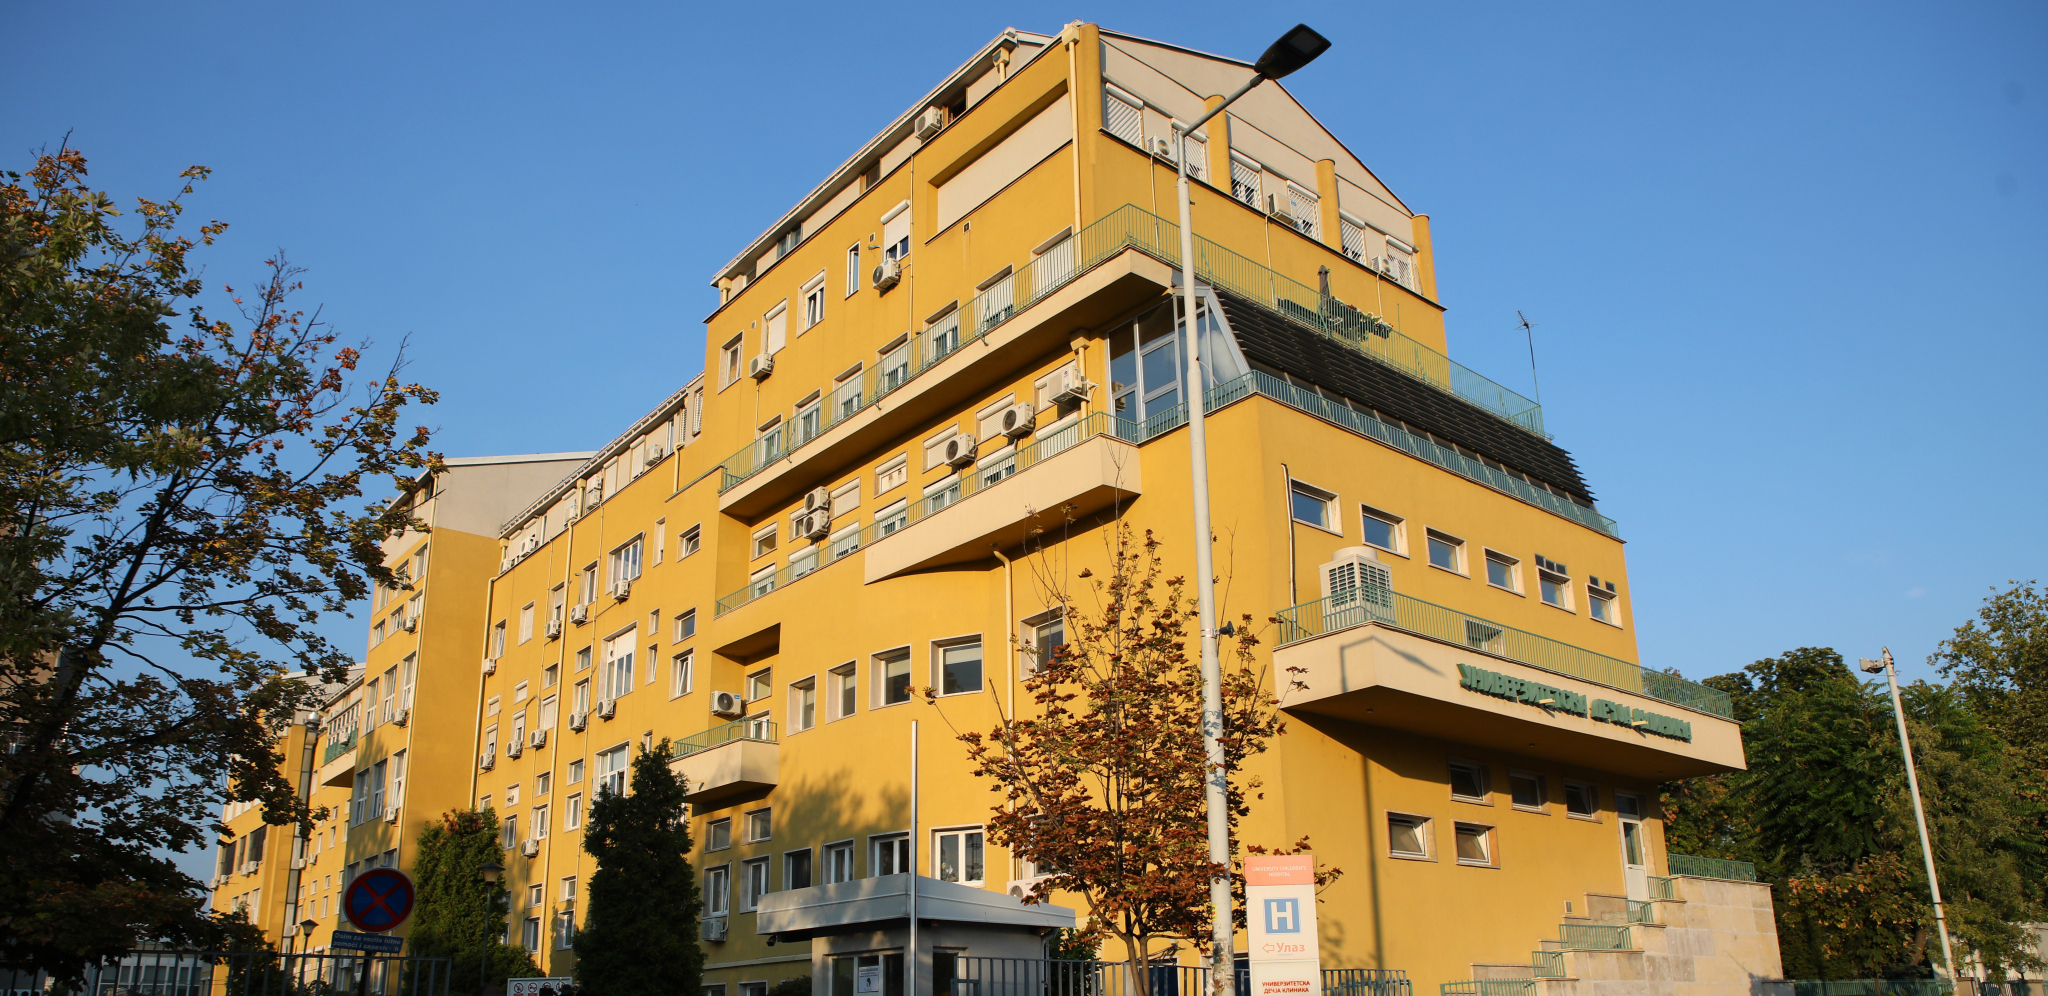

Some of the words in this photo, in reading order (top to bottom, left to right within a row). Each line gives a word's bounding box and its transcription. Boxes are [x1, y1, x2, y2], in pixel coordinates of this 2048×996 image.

[1270, 901, 1294, 930] H
[334, 932, 352, 940] Osim
[1276, 942, 1305, 953] Улаз
